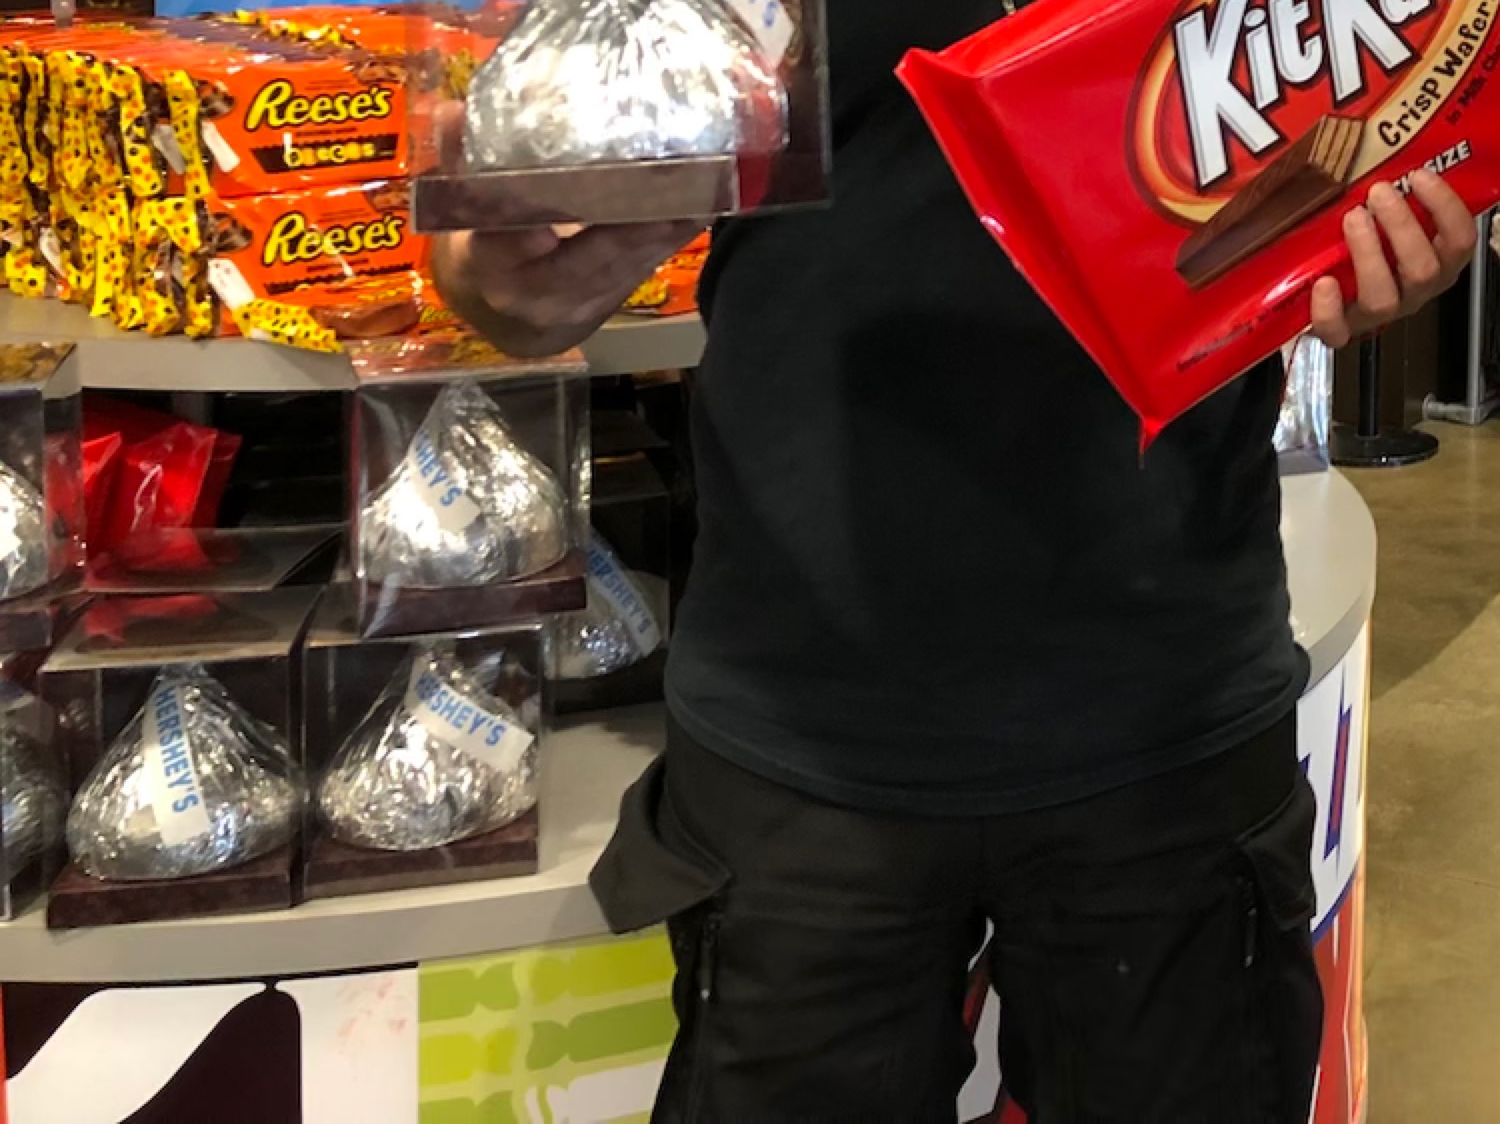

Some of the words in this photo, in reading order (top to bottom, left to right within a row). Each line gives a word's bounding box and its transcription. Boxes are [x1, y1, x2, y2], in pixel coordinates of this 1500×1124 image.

[244, 78, 393, 132] Reese's
[1377, 77, 1442, 148] Crisp
[262, 212, 404, 266] Reese's
[155, 686, 199, 813] HERSHEY'S
